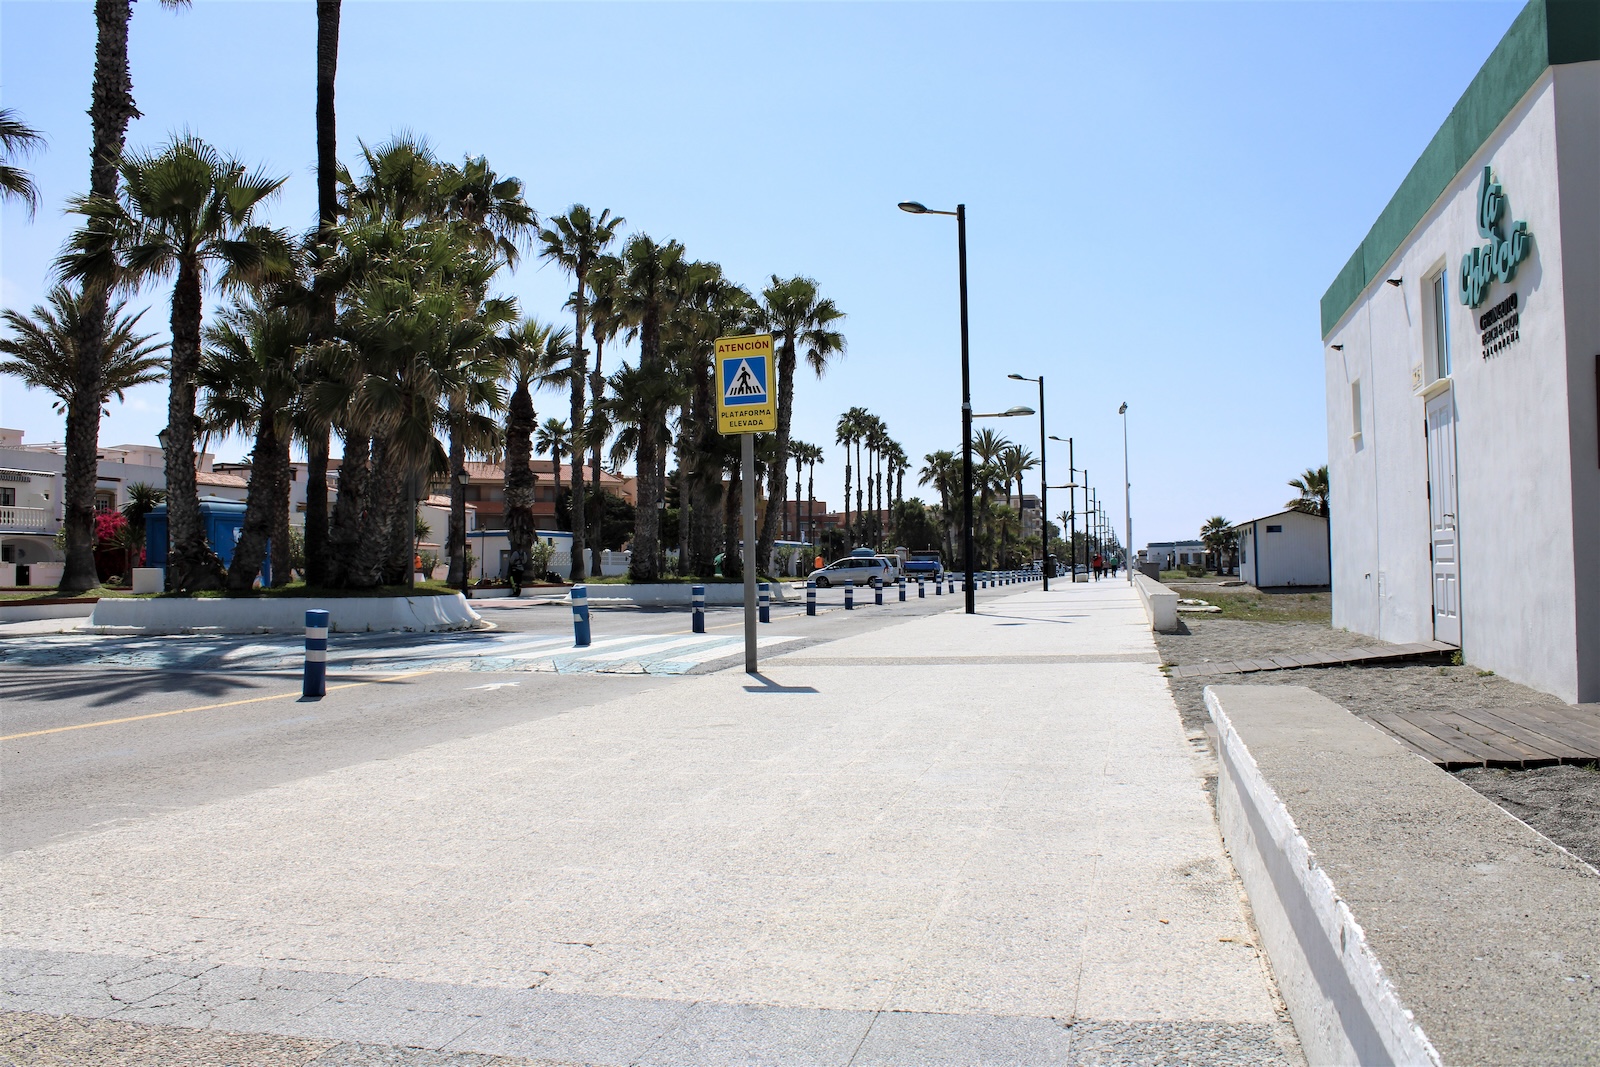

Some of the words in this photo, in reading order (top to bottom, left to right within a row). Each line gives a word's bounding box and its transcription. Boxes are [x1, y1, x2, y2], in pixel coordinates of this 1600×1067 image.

[718, 340, 769, 352] ATENCIÓN
[721, 409, 771, 418] PLATAFORMA
[729, 420, 764, 428] ELEVADA
